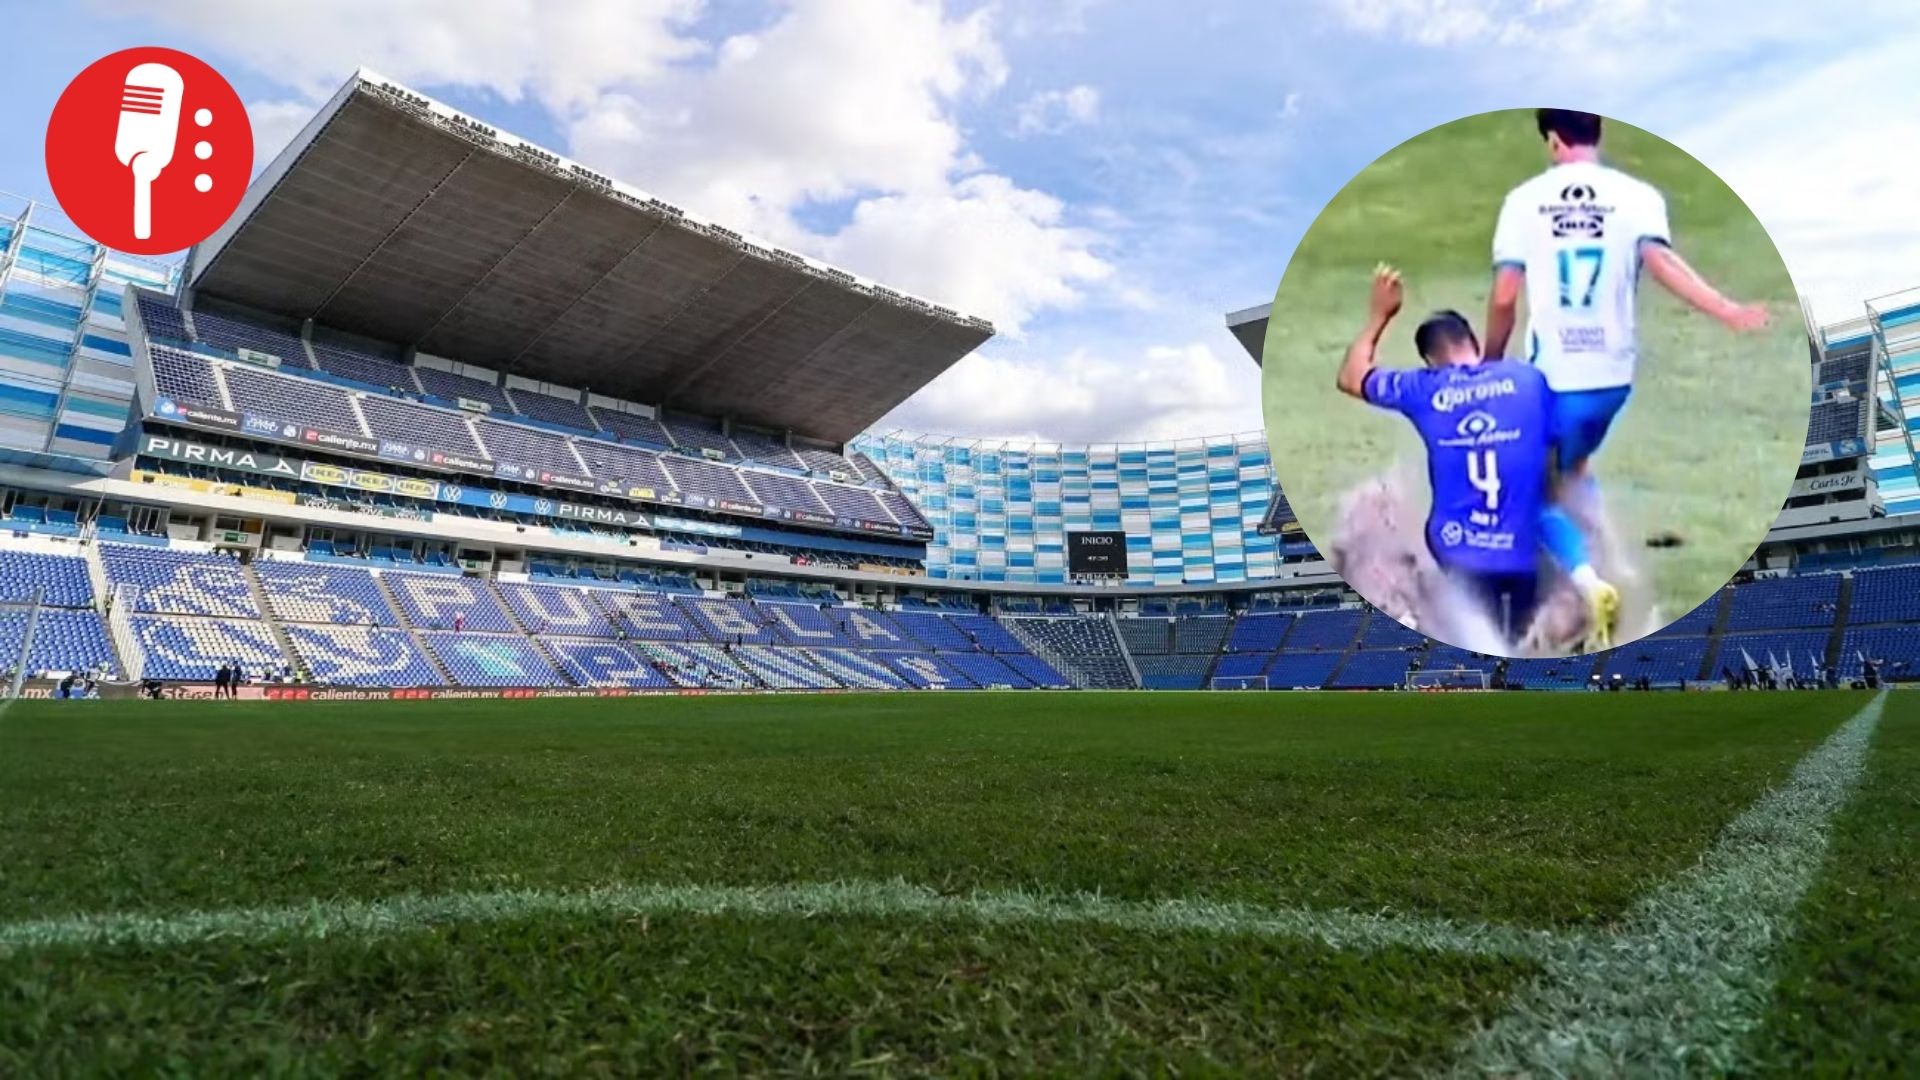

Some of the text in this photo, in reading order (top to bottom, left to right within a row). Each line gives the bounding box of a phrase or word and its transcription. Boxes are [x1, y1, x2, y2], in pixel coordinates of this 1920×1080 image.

[1557, 247, 1604, 308] 17
[1432, 378, 1516, 413] Corona
[187, 410, 238, 426] caliente.mx
[318, 434, 378, 452] caliente.mx
[147, 437, 258, 469] PIRMA
[443, 456, 494, 472] caliente.mx
[309, 467, 346, 482] IKEA
[354, 474, 391, 488] IKEA
[1467, 449, 1501, 511] 4
[398, 481, 433, 496] IKEA
[559, 503, 627, 524] PIRMA
[1081, 536, 1113, 545] INICIO
[310, 688, 390, 700] caliente.mx
[431, 688, 500, 699] caliente.mx
[536, 688, 595, 697] caliente.mx
